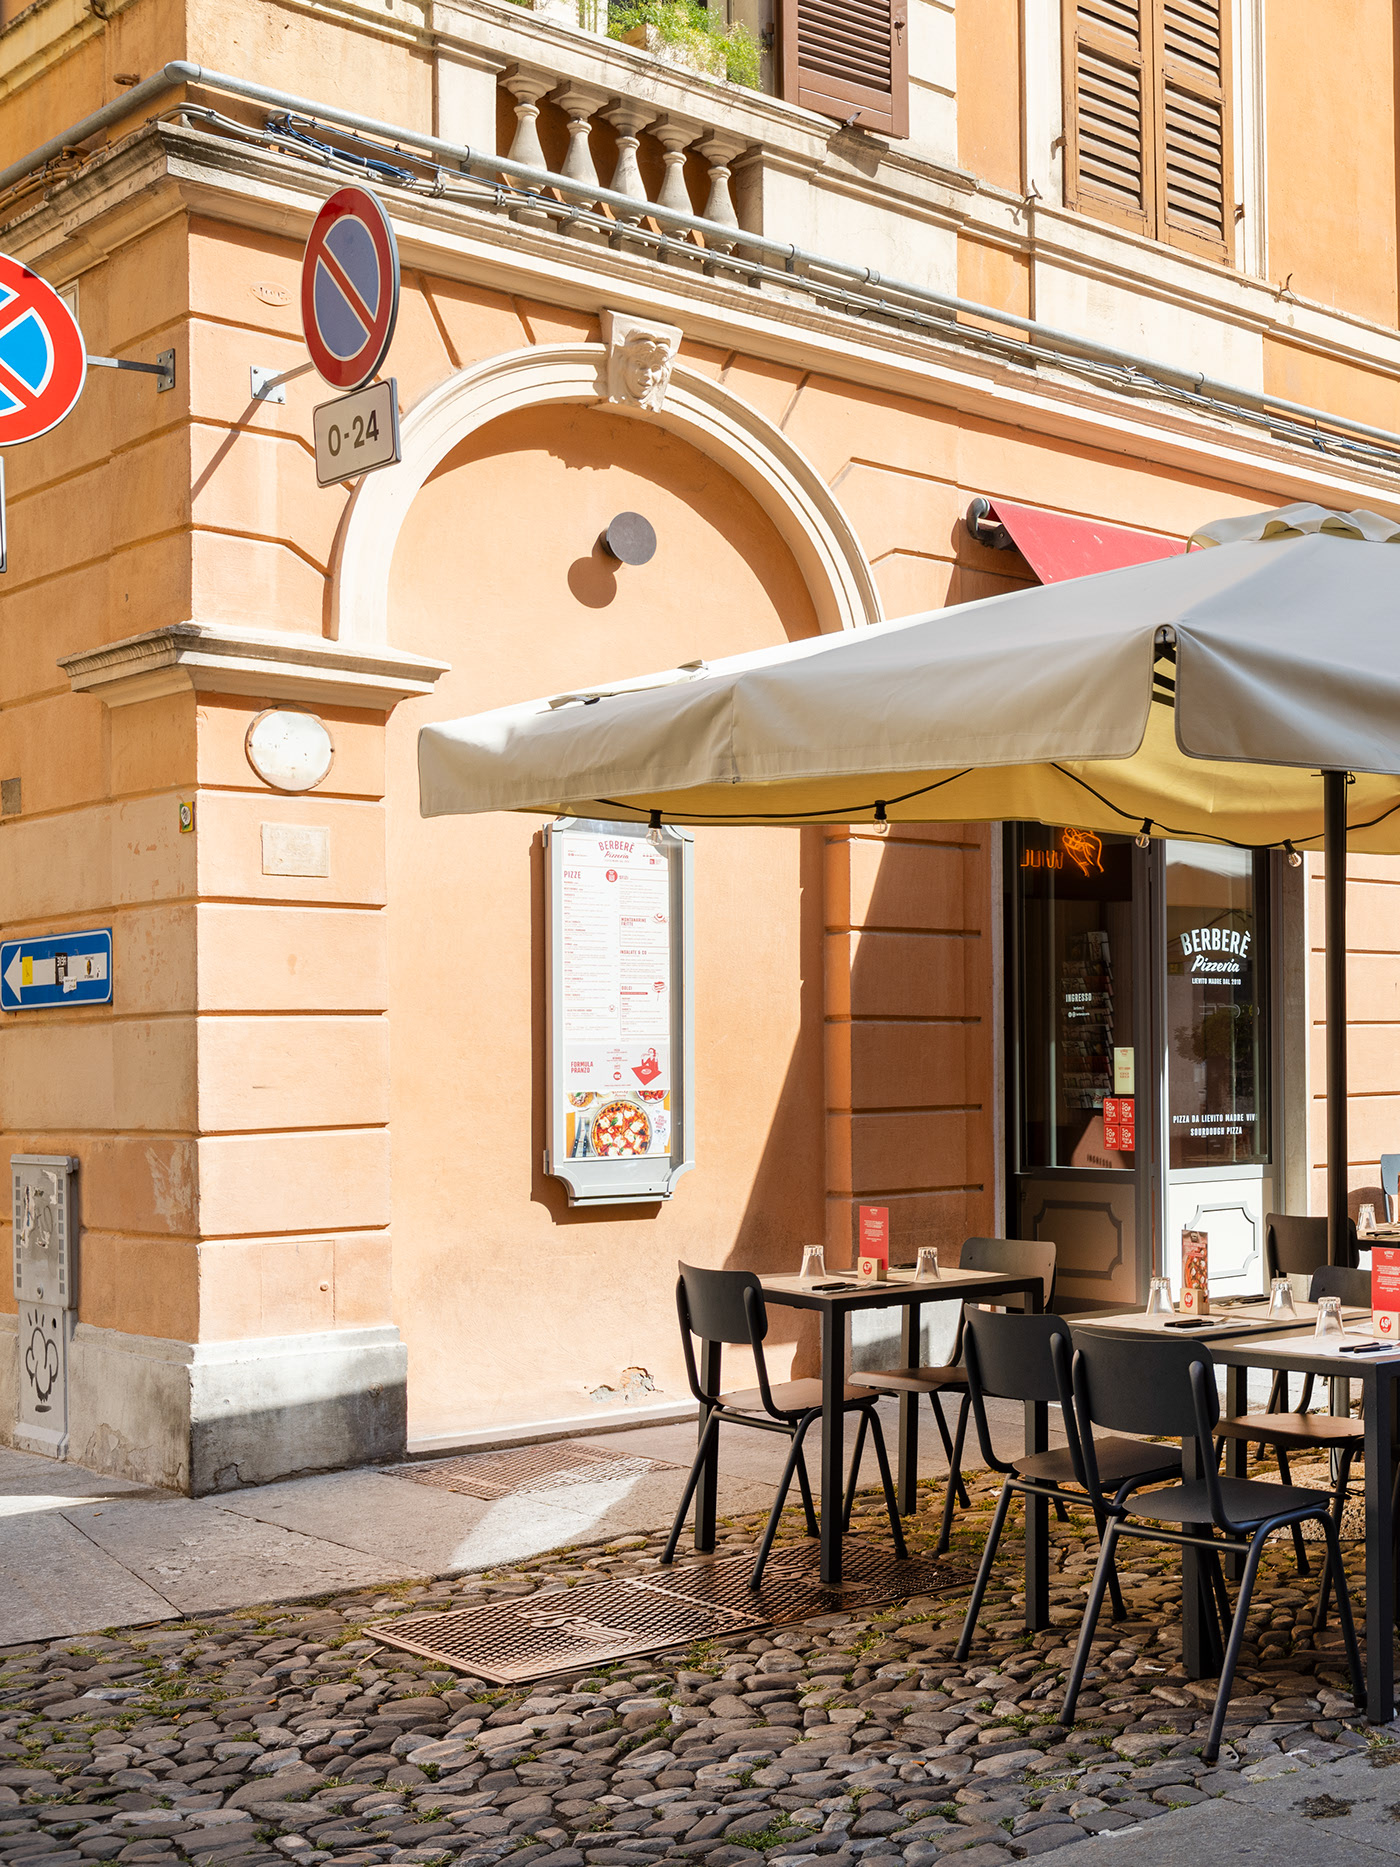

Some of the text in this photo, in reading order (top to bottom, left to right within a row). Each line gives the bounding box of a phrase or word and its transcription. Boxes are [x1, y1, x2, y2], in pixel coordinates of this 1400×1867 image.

[328, 409, 379, 457] 0-24
[598, 840, 635, 853] BERBERÈ
[564, 870, 581, 879] PIZZE
[1180, 928, 1251, 958] BERBERÈ
[1191, 954, 1240, 972] Pizzeria
[1065, 993, 1092, 1003] INGRESSO
[1173, 1115, 1189, 1123] PIZZA
[1192, 1115, 1199, 1123] DA
[1201, 1114, 1223, 1122] LIEVITO
[1225, 1114, 1244, 1122] MADRE
[1190, 1127, 1243, 1136] SOURDOUGH PIZZA
